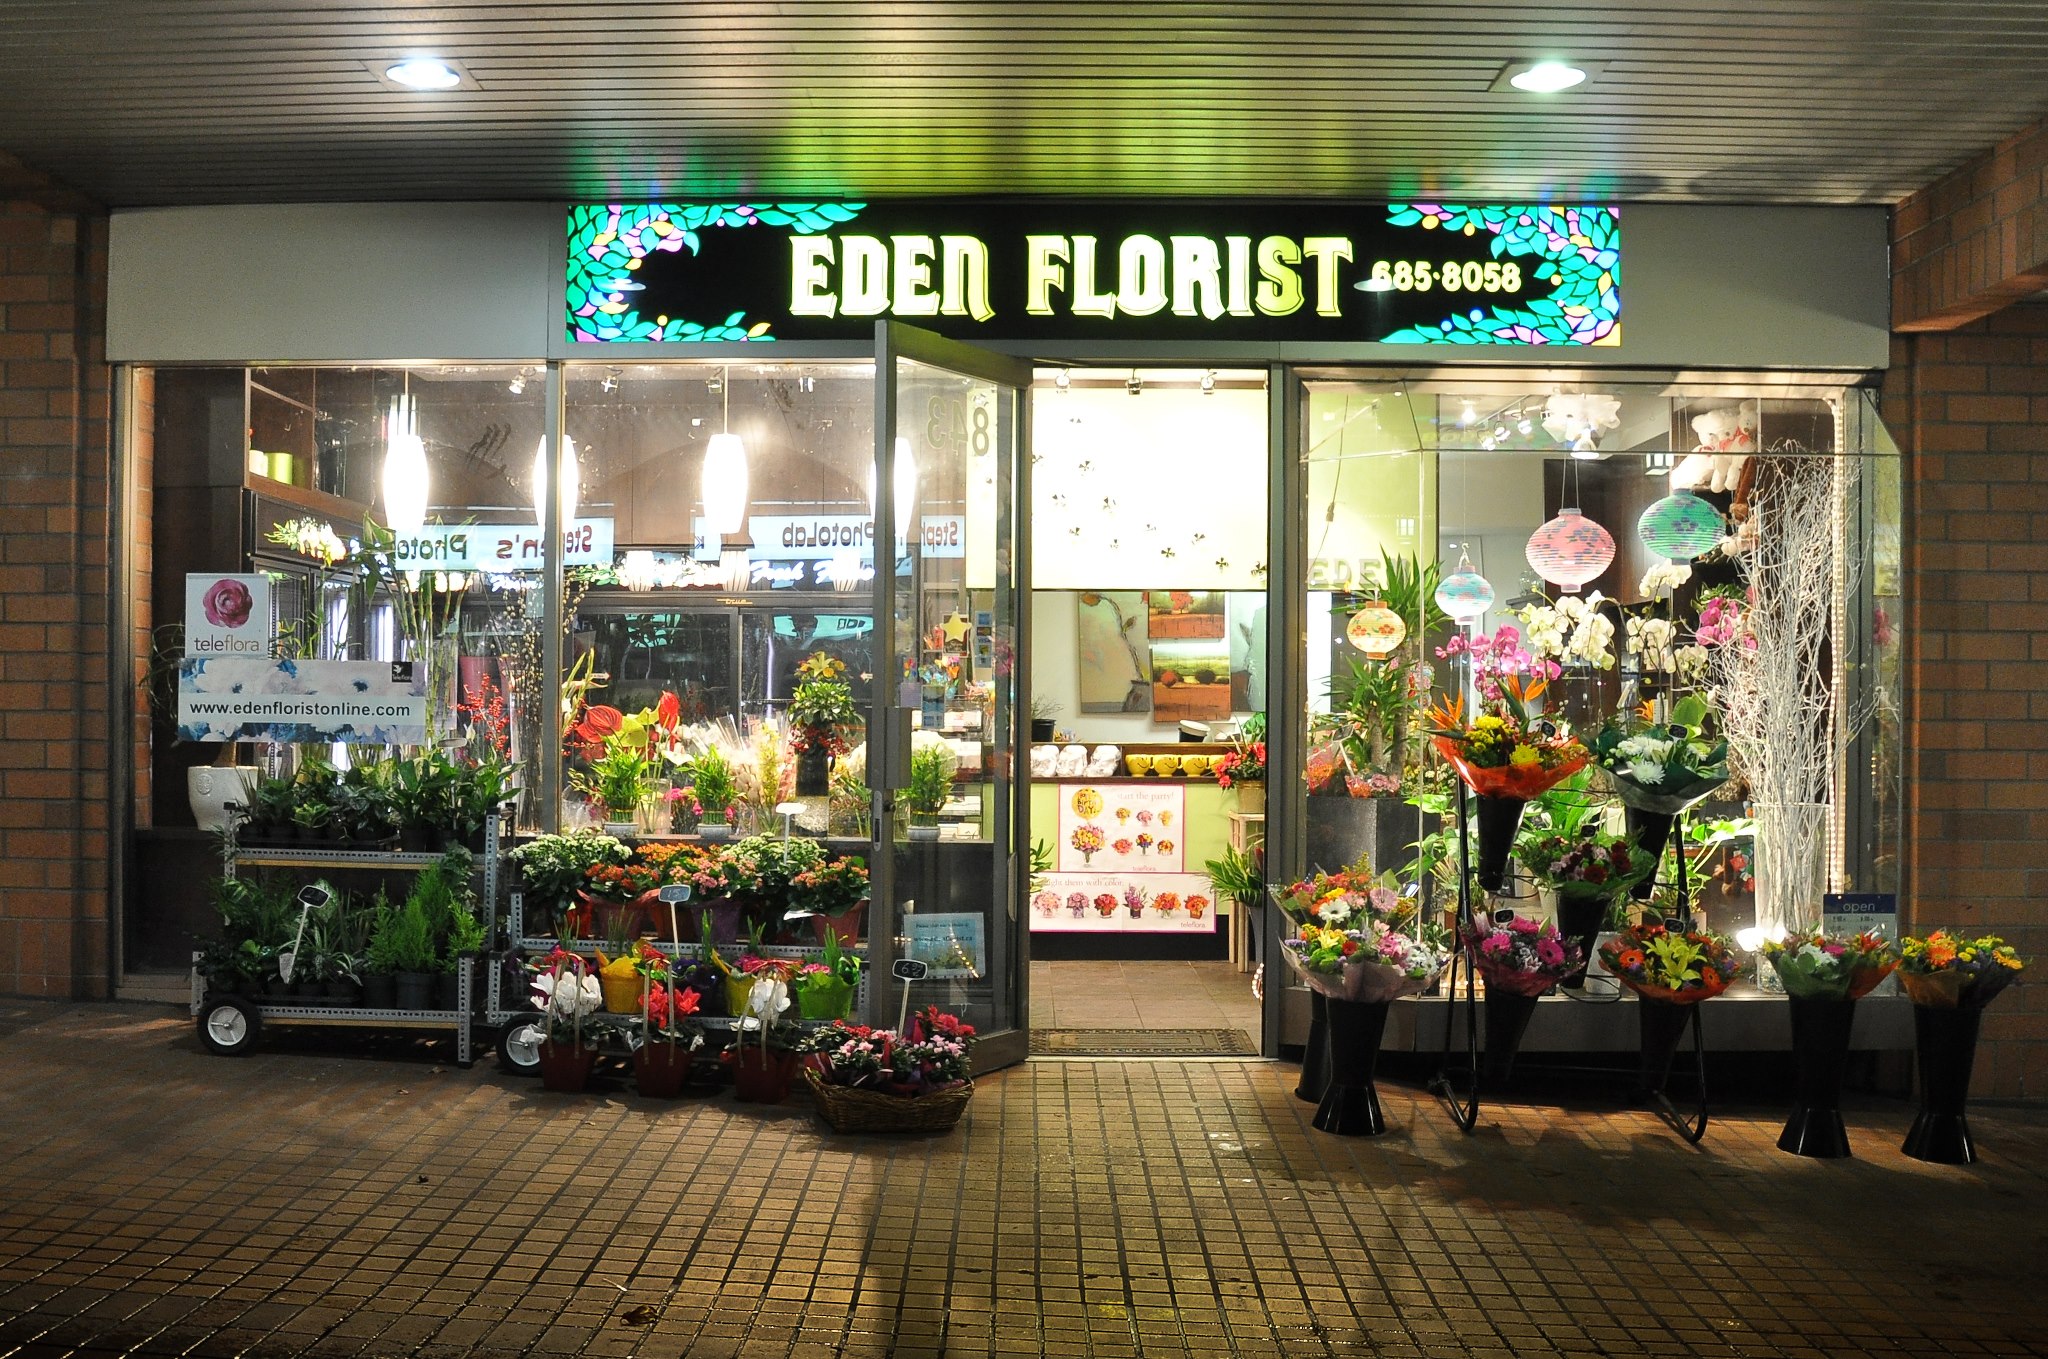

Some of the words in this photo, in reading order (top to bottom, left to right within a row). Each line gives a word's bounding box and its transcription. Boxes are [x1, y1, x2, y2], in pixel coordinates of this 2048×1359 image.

[789, 233, 996, 323] EDEN
[1025, 233, 1354, 322] FLORIST
[194, 634, 260, 652] teleflora
[190, 701, 411, 717] www.edenfloristonline.com
[1842, 903, 1876, 914] open
